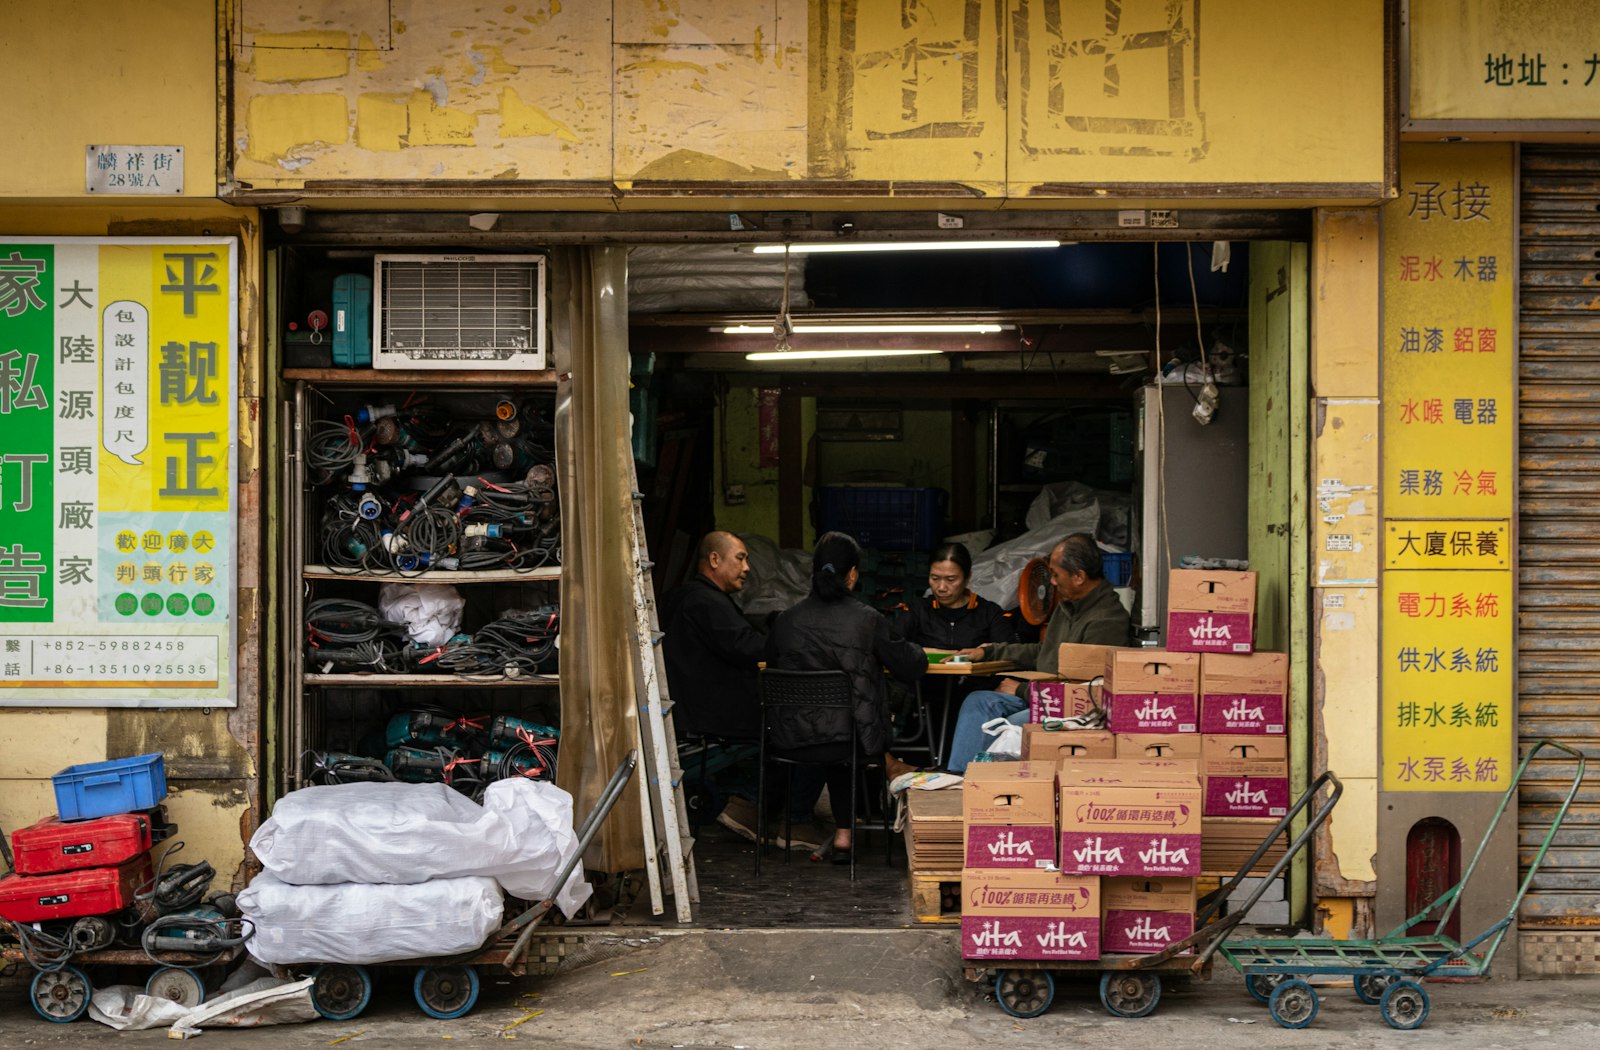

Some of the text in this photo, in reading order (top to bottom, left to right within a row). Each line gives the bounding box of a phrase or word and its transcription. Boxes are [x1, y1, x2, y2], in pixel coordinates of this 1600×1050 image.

[97, 152, 173, 171] 麟祥街
[1408, 181, 1490, 221] 承接
[1400, 256, 1498, 282] 泥水 木器
[1400, 327, 1498, 353] 油漆 鋁窗
[114, 309, 135, 444] 包設計包度尺
[1400, 398, 1498, 424] 水喉 電器
[59, 280, 95, 586] 大陸源頭廠家
[1399, 469, 1497, 496] 渠務 冷氣
[117, 533, 213, 550] 歡迎廣大
[1398, 530, 1499, 557] 大廈保養
[117, 565, 213, 582] 判頭行家
[1398, 592, 1499, 618] 電力系統
[1188, 616, 1232, 639] vita
[43, 640, 184, 651] +852-59882458
[43, 664, 206, 674] +86-13510925535
[1397, 647, 1498, 673] 供水系統
[1039, 687, 1061, 721] vit
[1134, 698, 1177, 720] vita
[1222, 698, 1265, 721] vita
[1397, 702, 1498, 728] 排水系統
[1397, 757, 1498, 783] 水泵系統
[1225, 781, 1268, 804] vita
[987, 831, 1034, 855] vita
[1072, 837, 1124, 864] vita
[1138, 838, 1189, 864] vita
[971, 920, 1023, 947] vita
[1036, 921, 1088, 948] vita
[1124, 916, 1171, 941] vita
